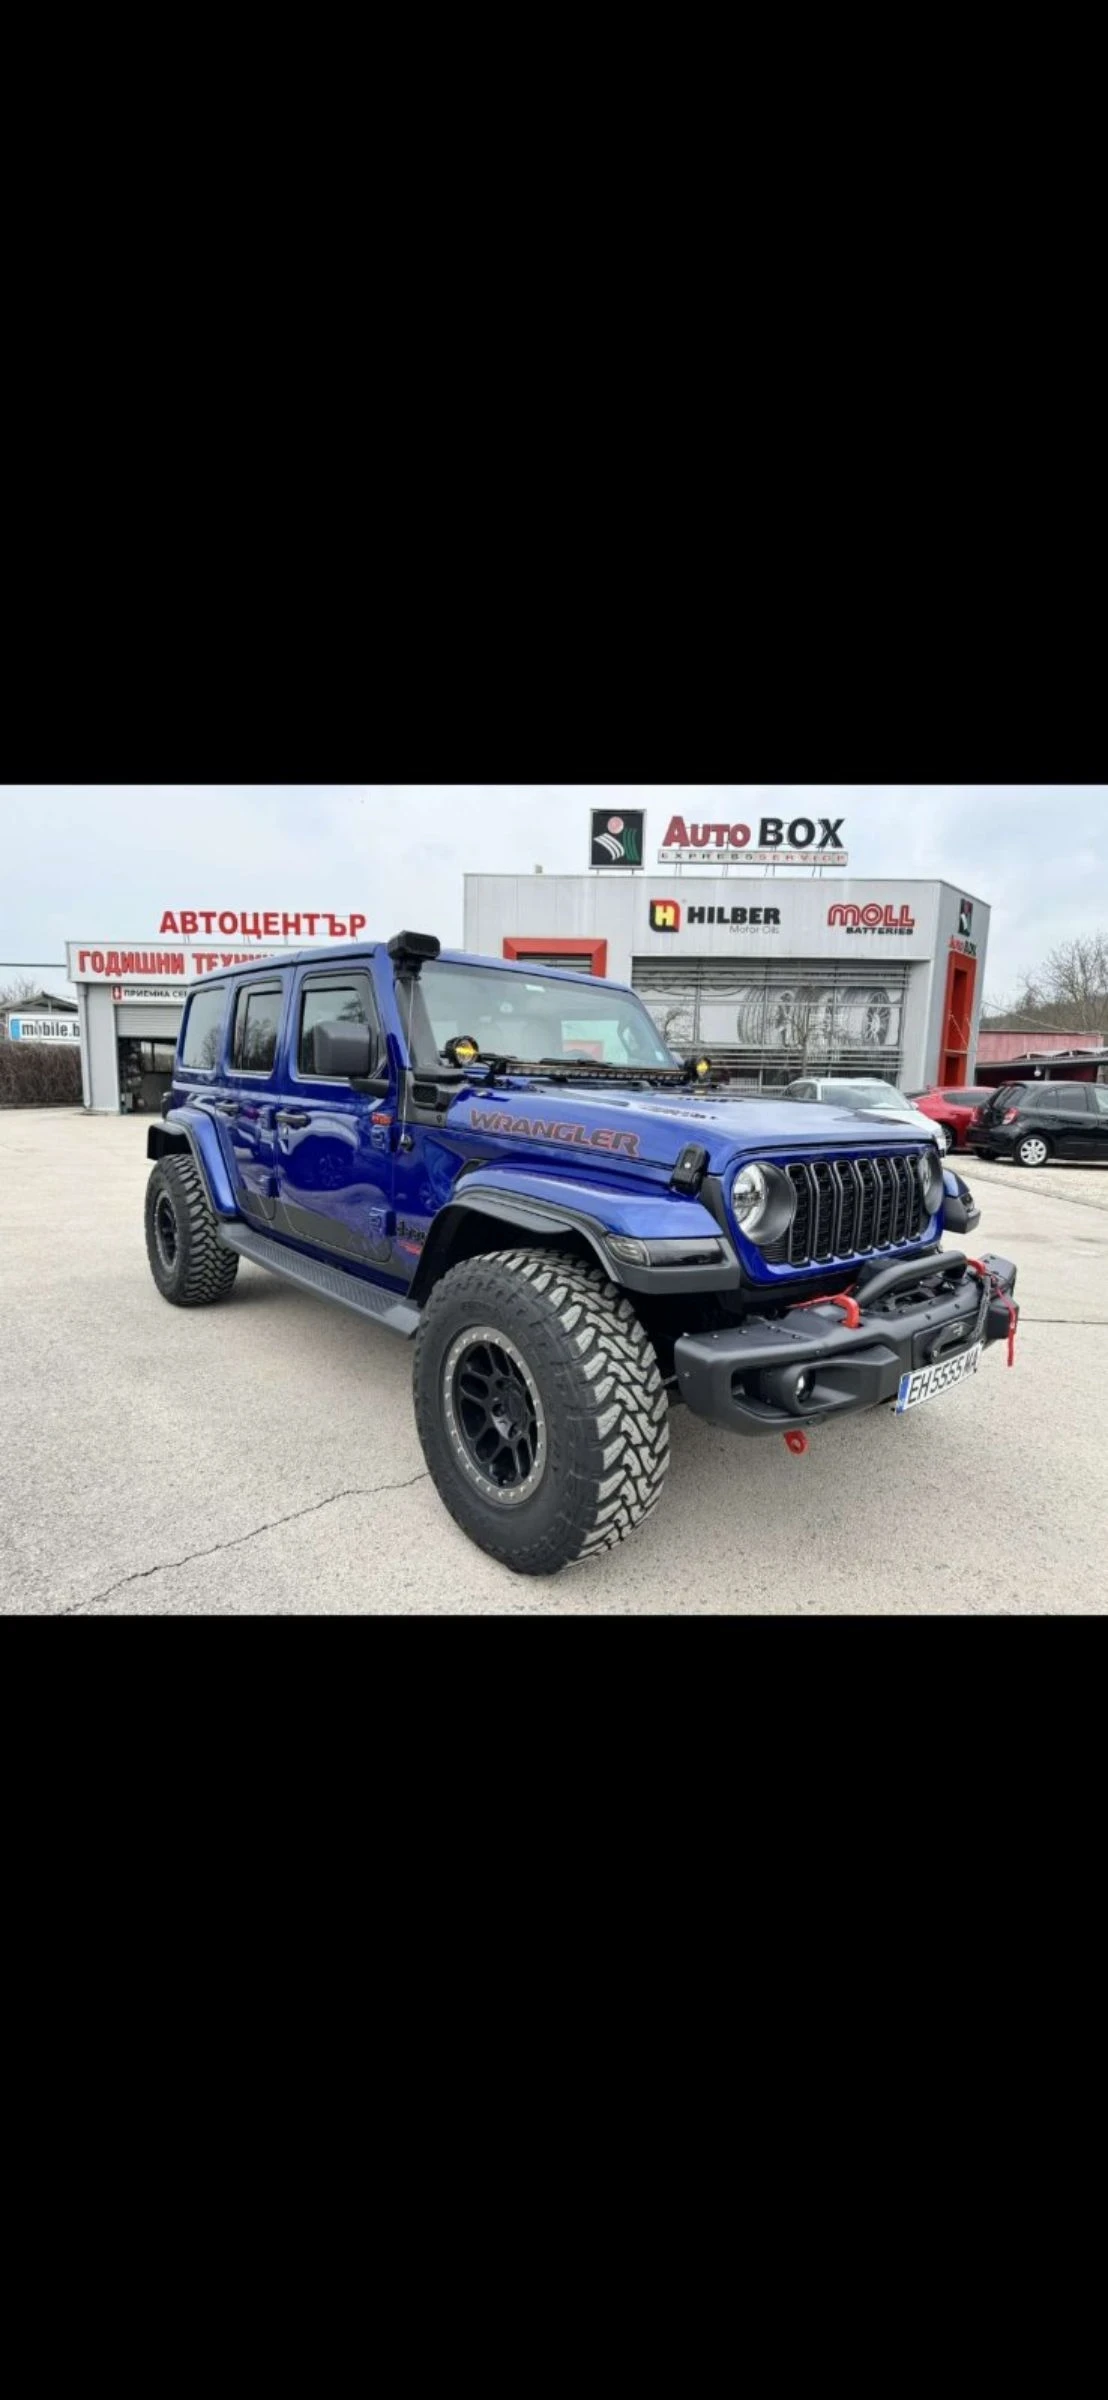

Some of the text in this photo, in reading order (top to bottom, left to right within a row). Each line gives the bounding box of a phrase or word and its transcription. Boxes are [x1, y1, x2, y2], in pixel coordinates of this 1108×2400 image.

[758, 817, 845, 849] BOX
[159, 910, 367, 939] АВТОЦЕНТЪР
[687, 905, 781, 925] HILBER
[827, 903, 915, 927] MOLL
[729, 925, 759, 935] Motor
[846, 926, 914, 936] BATTERIES
[78, 951, 185, 976] ГОДИШНИ
[124, 988, 171, 998] ПРИЕМНА
[470, 1109, 641, 1157] WRANGLER
